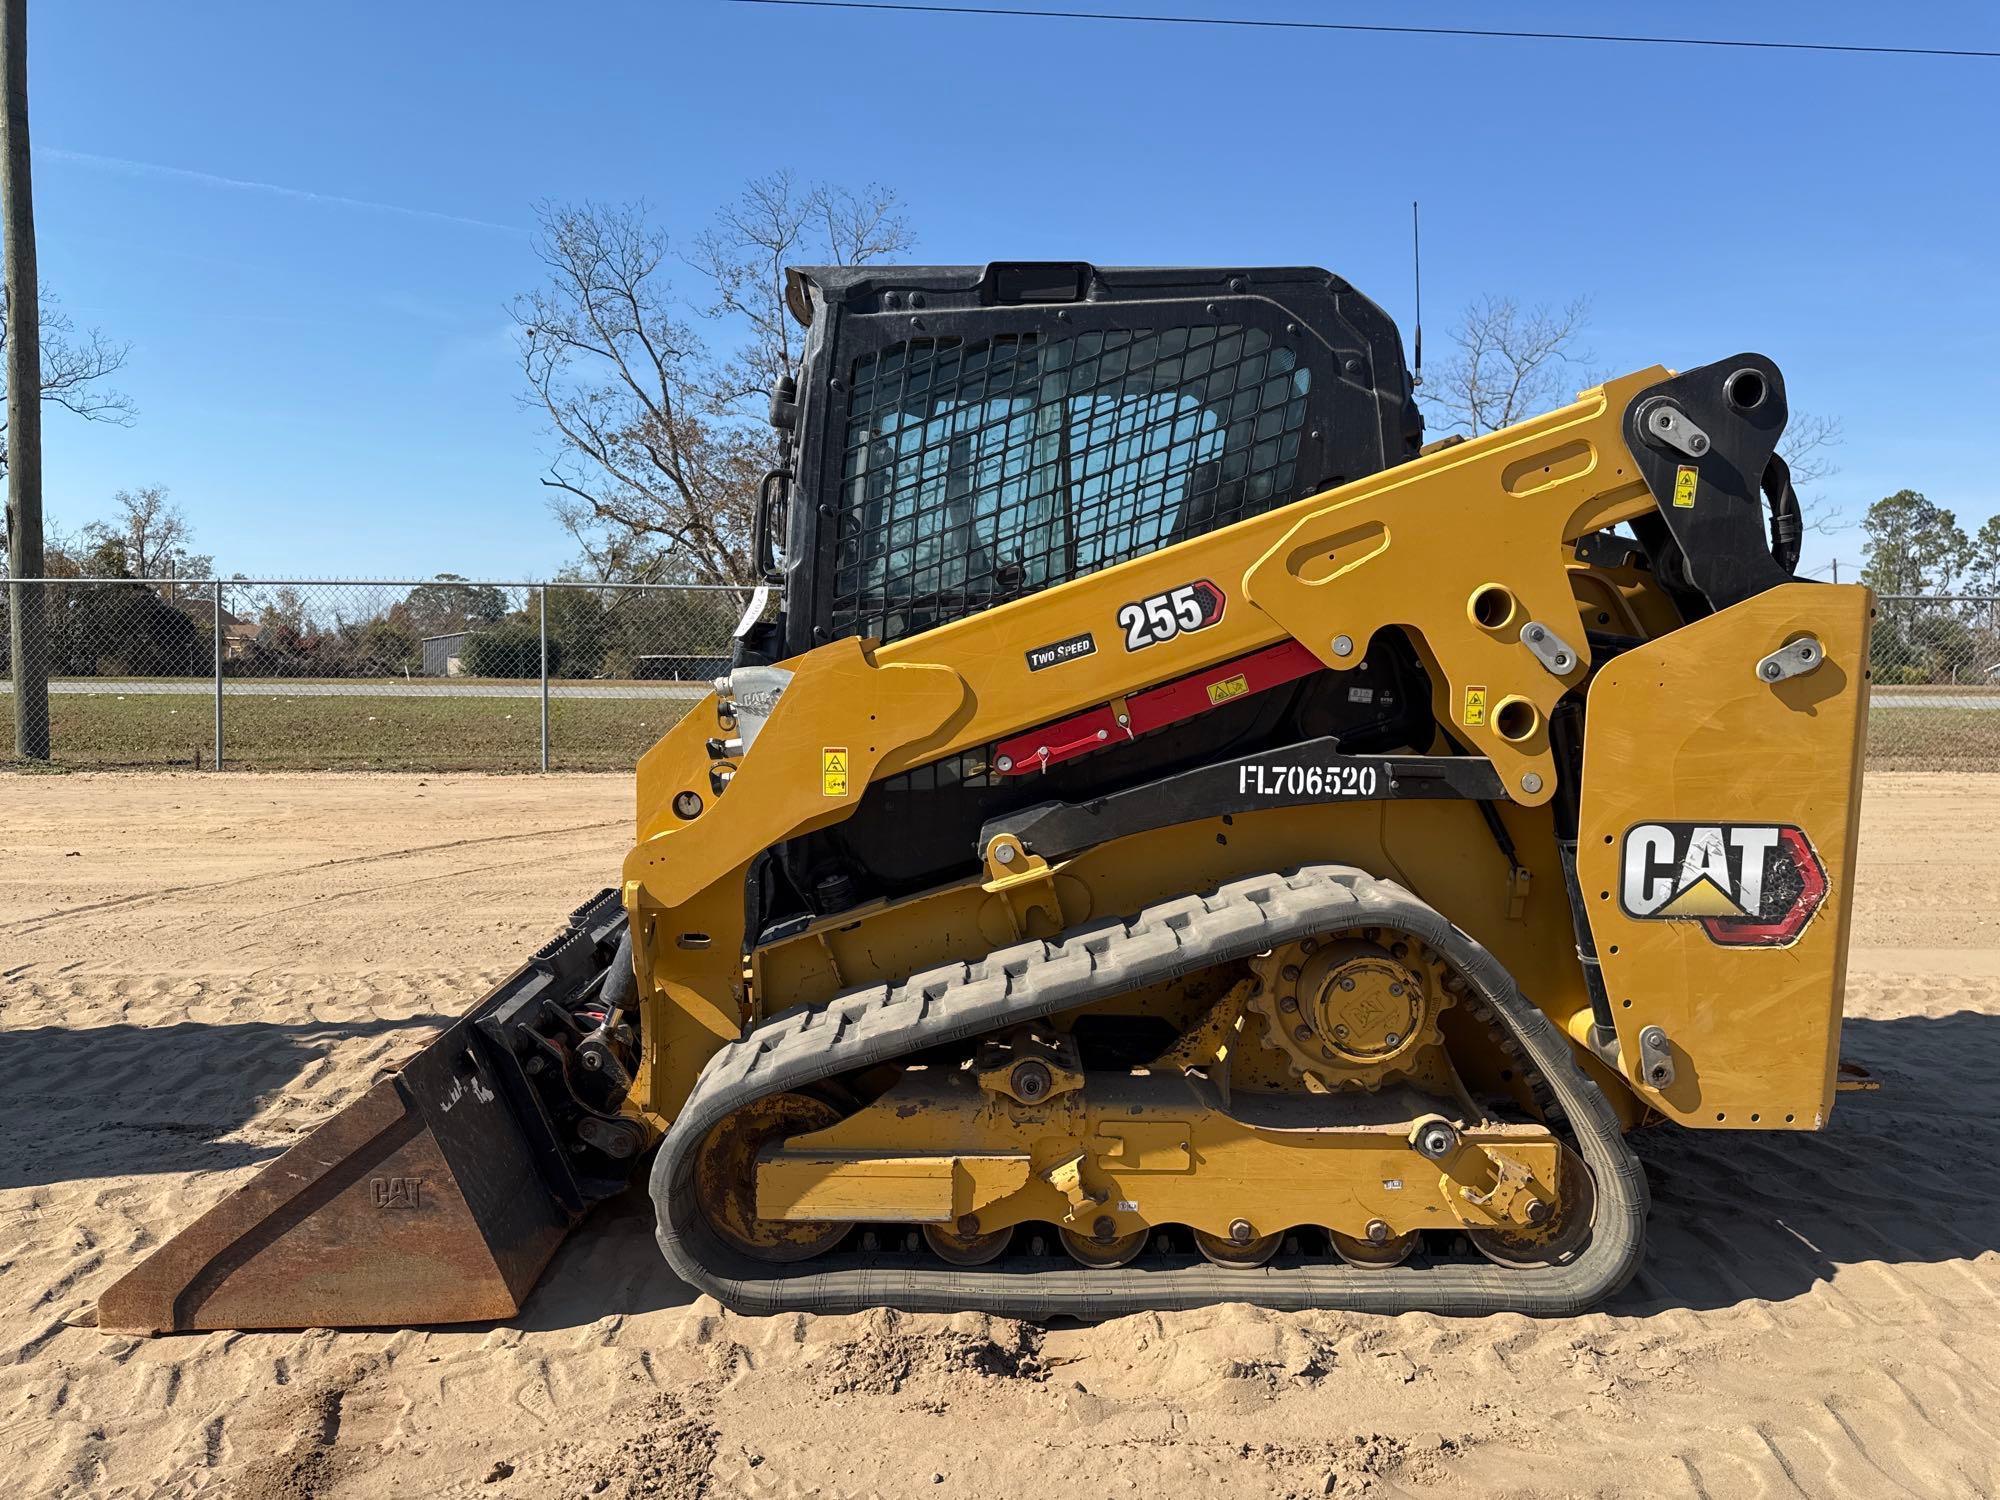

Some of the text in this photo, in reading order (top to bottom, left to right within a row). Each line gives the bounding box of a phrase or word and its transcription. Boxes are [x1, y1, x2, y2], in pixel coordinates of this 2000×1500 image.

[1119, 585, 1204, 650] 255
[1239, 765, 1376, 795] FL706520
[1624, 824, 1779, 916] CAT
[370, 1177, 423, 1209] CAT
